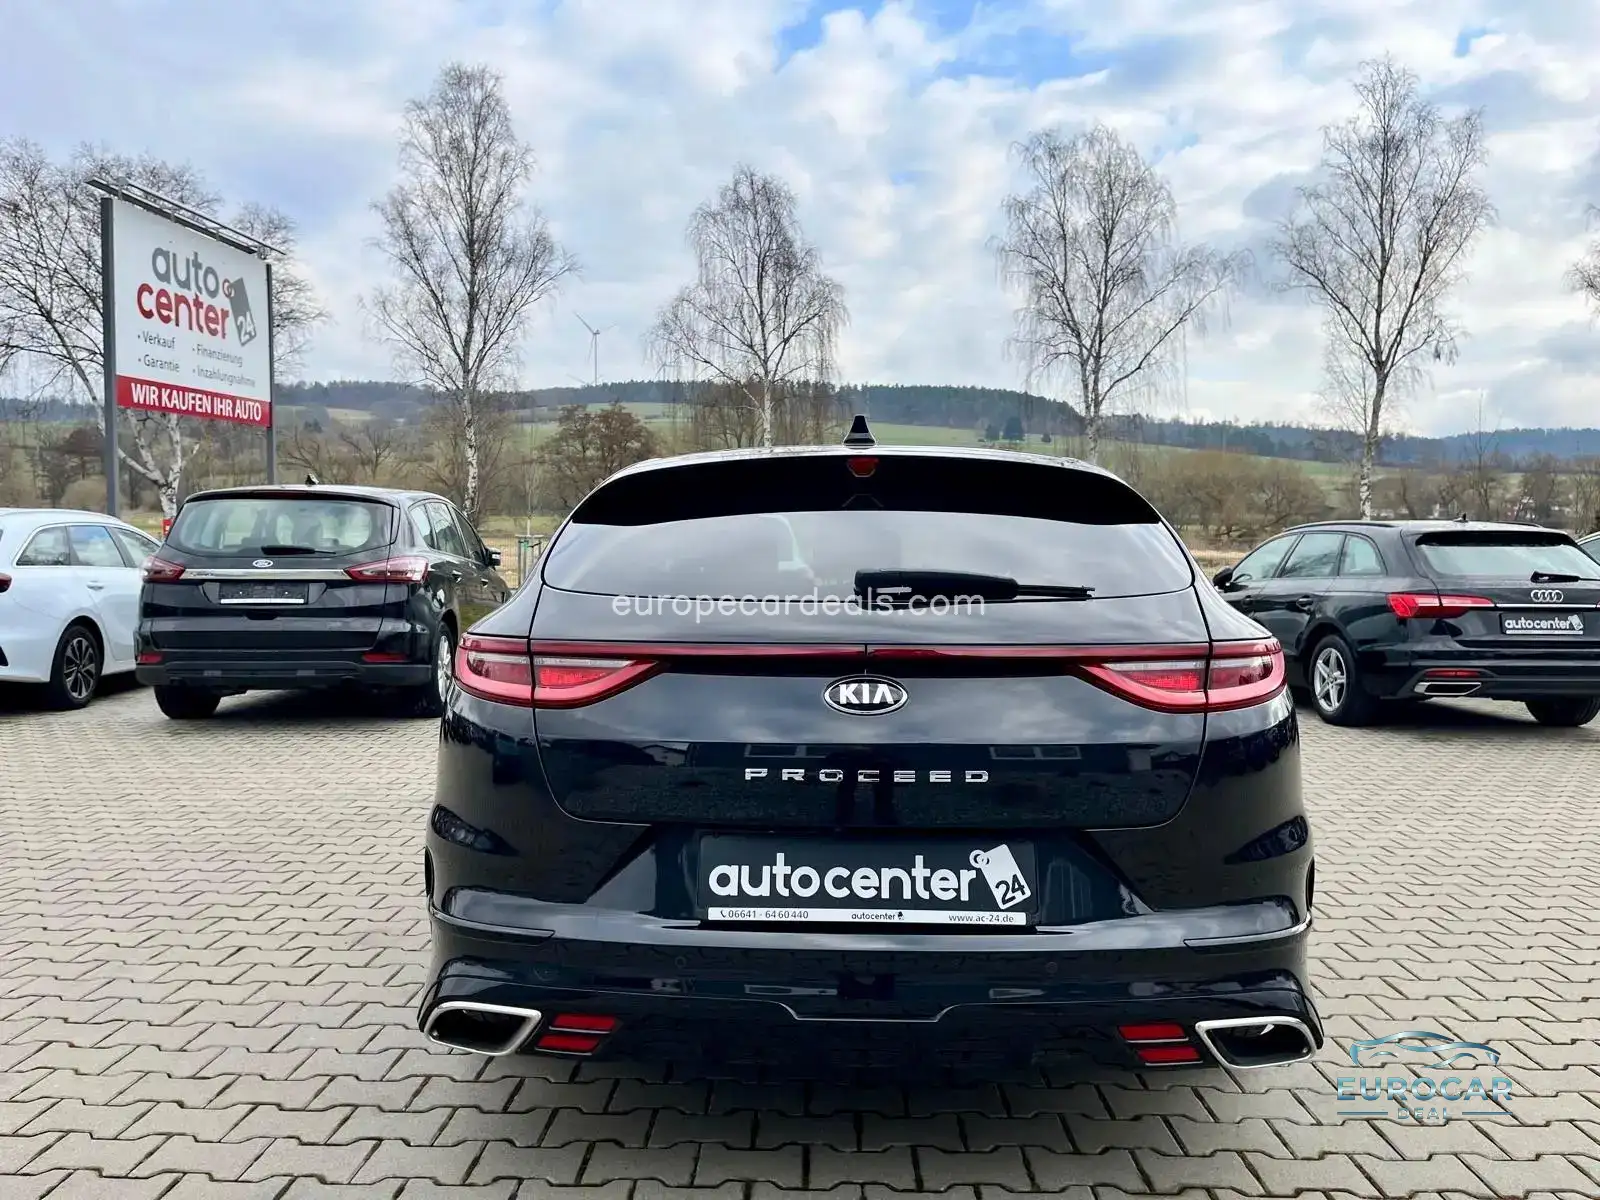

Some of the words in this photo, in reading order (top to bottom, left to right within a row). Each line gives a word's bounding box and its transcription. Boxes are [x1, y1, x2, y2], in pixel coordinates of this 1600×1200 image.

[152, 247, 219, 299] auto
[136, 282, 230, 339] center
[236, 311, 256, 341] 24
[142, 330, 176, 350] Verkauf
[143, 354, 181, 373] Garantie
[130, 382, 160, 407] WIR
[161, 388, 212, 414] KAUFEN
[213, 399, 234, 418] IHR
[234, 400, 262, 421] AUTO
[1505, 616, 1570, 629] autocenter
[837, 683, 895, 706] KIA
[744, 767, 990, 784] PROCEED
[708, 852, 977, 901] autocenter
[995, 880, 1027, 906] 24
[728, 908, 757, 920] 06641
[851, 911, 897, 922] autocenter
[948, 914, 1014, 923] www.ac-24.de
